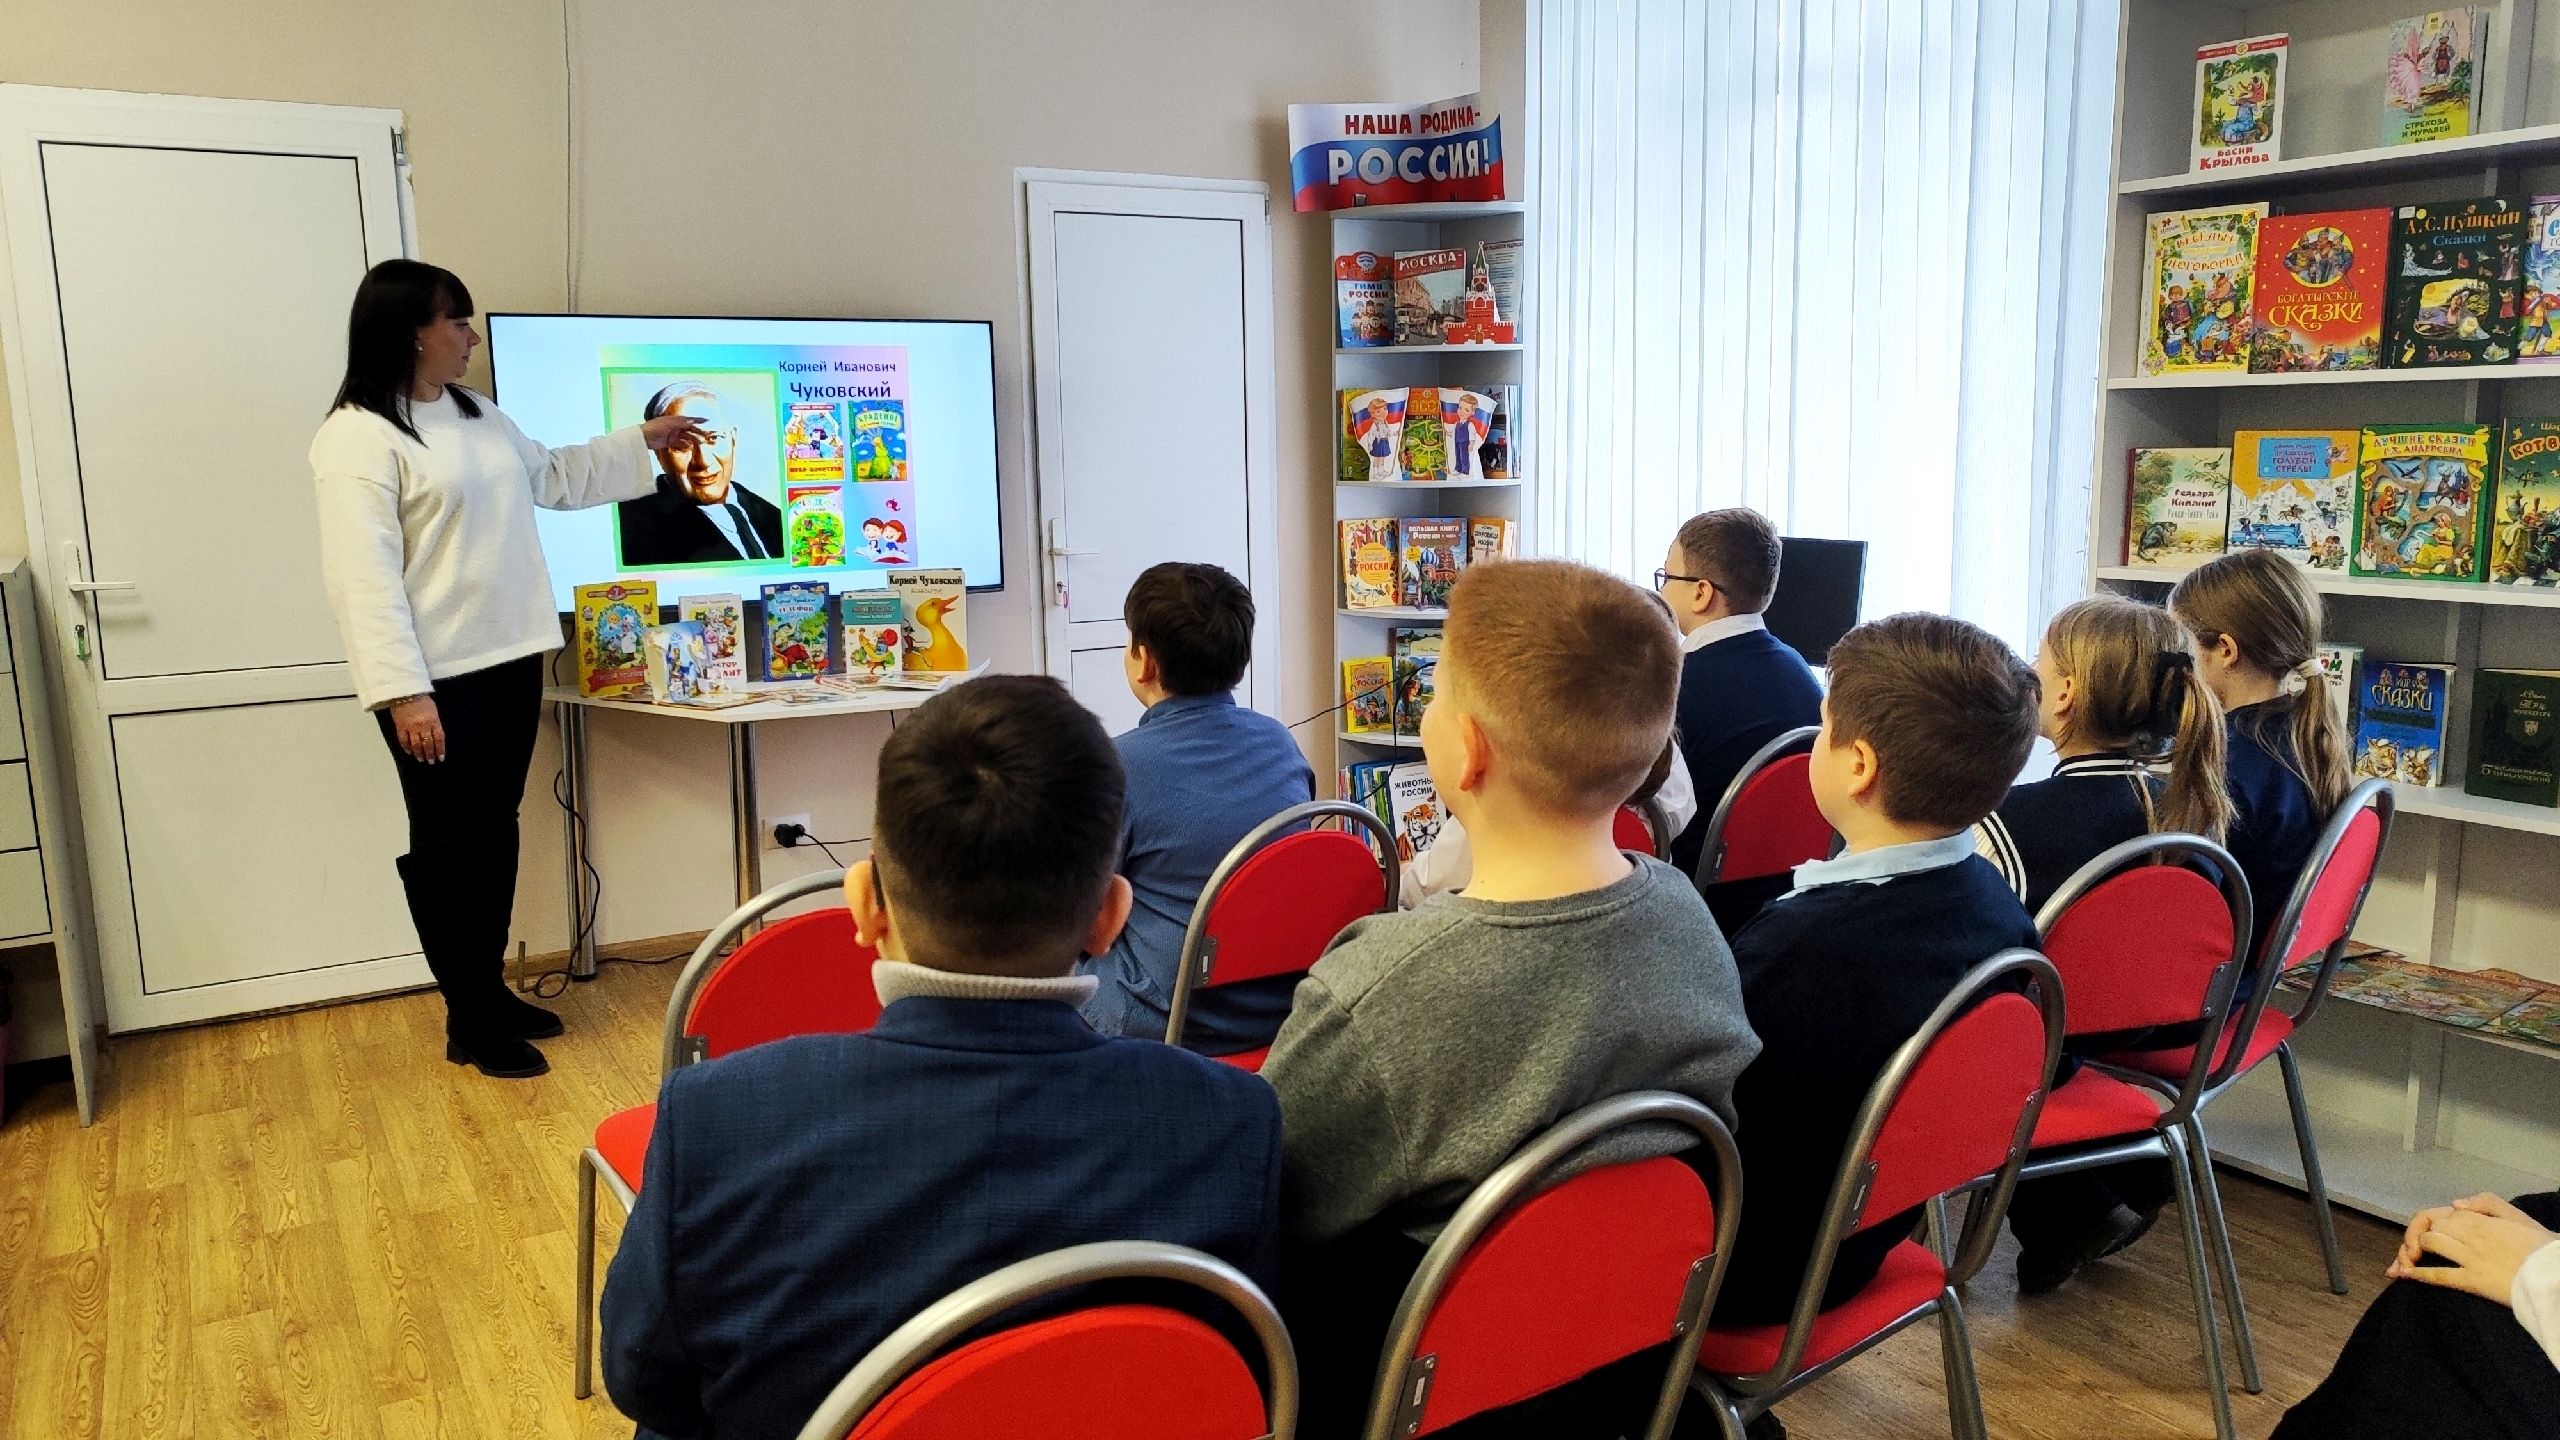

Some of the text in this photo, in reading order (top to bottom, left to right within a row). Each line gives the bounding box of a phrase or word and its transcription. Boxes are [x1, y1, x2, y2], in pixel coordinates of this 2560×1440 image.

[1344, 105, 1481, 135] НАША РОДИНА-
[2404, 117, 2449, 130] СТРЕКОЗА
[2410, 124, 2451, 137] МУРАВЕЙ
[1328, 137, 1490, 186] РОССИЯ!
[2432, 234, 2487, 246] Сказки
[1348, 290, 1389, 299] РОССИИ
[2268, 302, 2364, 332] СКАЗКИ
[779, 360, 897, 375] Корней Иванович
[790, 380, 892, 402] Чуковский
[2373, 434, 2477, 447] ЛУЧШИЕ СКАЗКИ
[2512, 437, 2558, 458] КОТ В
[2272, 457, 2317, 465] ГОЛУБОЙ
[2275, 465, 2312, 473] СТРЕЛЫ
[1359, 562, 1389, 572] РОССИИ
[888, 574, 963, 586] Корней Чуковский
[2371, 684, 2433, 711] СКАЗКИ
[1394, 777, 1434, 790] ЖИВОТНЫ
[1401, 786, 1433, 798] РОССИИ
